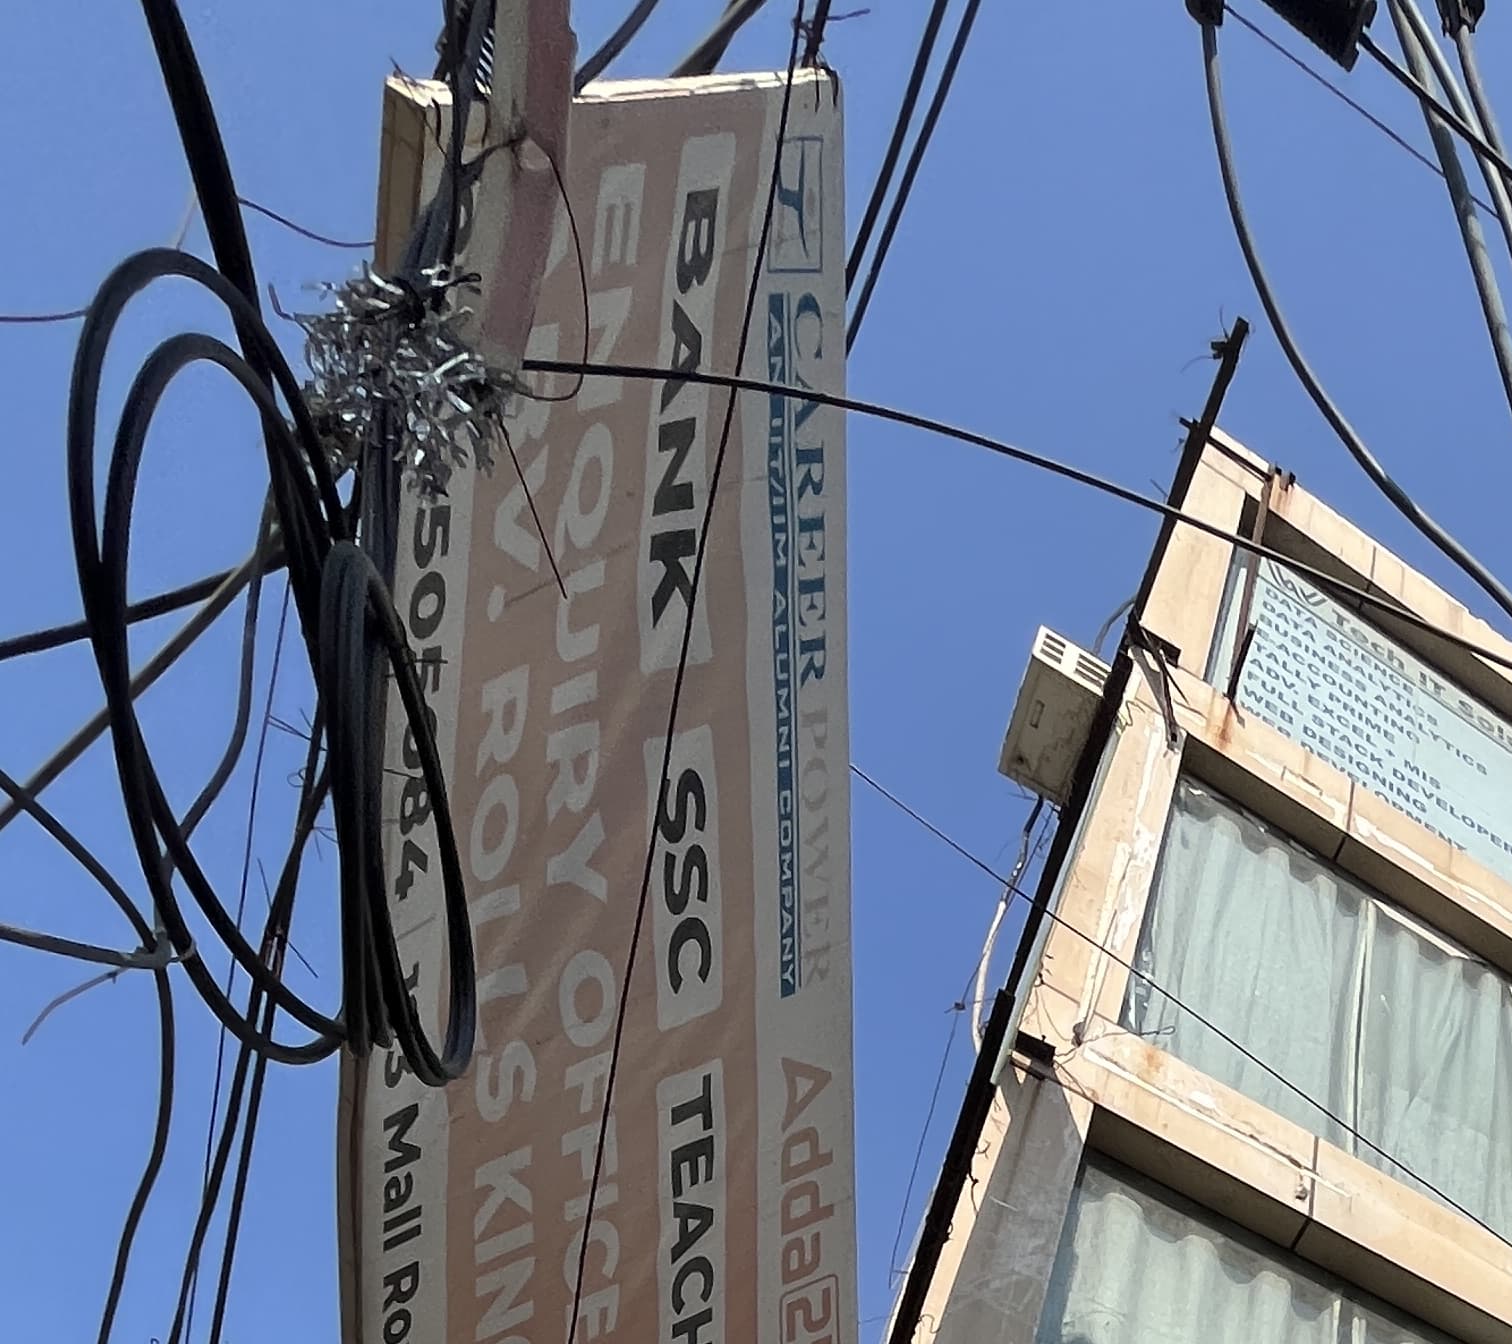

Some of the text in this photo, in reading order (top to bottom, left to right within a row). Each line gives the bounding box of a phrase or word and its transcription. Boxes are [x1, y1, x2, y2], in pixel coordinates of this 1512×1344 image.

[648, 188, 718, 629] BANK
[545, 164, 644, 903] ENQUIRY
[773, 587, 789, 767] ALUMNI
[793, 292, 830, 987] CAREER POWER
[1252, 640, 1396, 745] TALLY PRIME
[1255, 626, 1420, 745] E-ACCOUNTING
[1259, 612, 1488, 776] BUSINESS ANALYTICS
[1262, 599, 1438, 727] DATA ANALYTICS
[1264, 586, 1414, 696] DATA SCIENCE
[1417, 669, 1446, 699] IT
[1242, 684, 1427, 815] WEB DESIGNING
[1246, 669, 1304, 715] FULL
[1311, 713, 1384, 769] STACK
[1249, 655, 1299, 695] ADV.
[1307, 693, 1378, 748] EXCEL
[1403, 758, 1441, 791] MIS
[468, 665, 535, 1119] ROLLS
[657, 769, 711, 994] SSC
[778, 790, 794, 984] COMPANY
[380, 1102, 420, 1252] Mall
